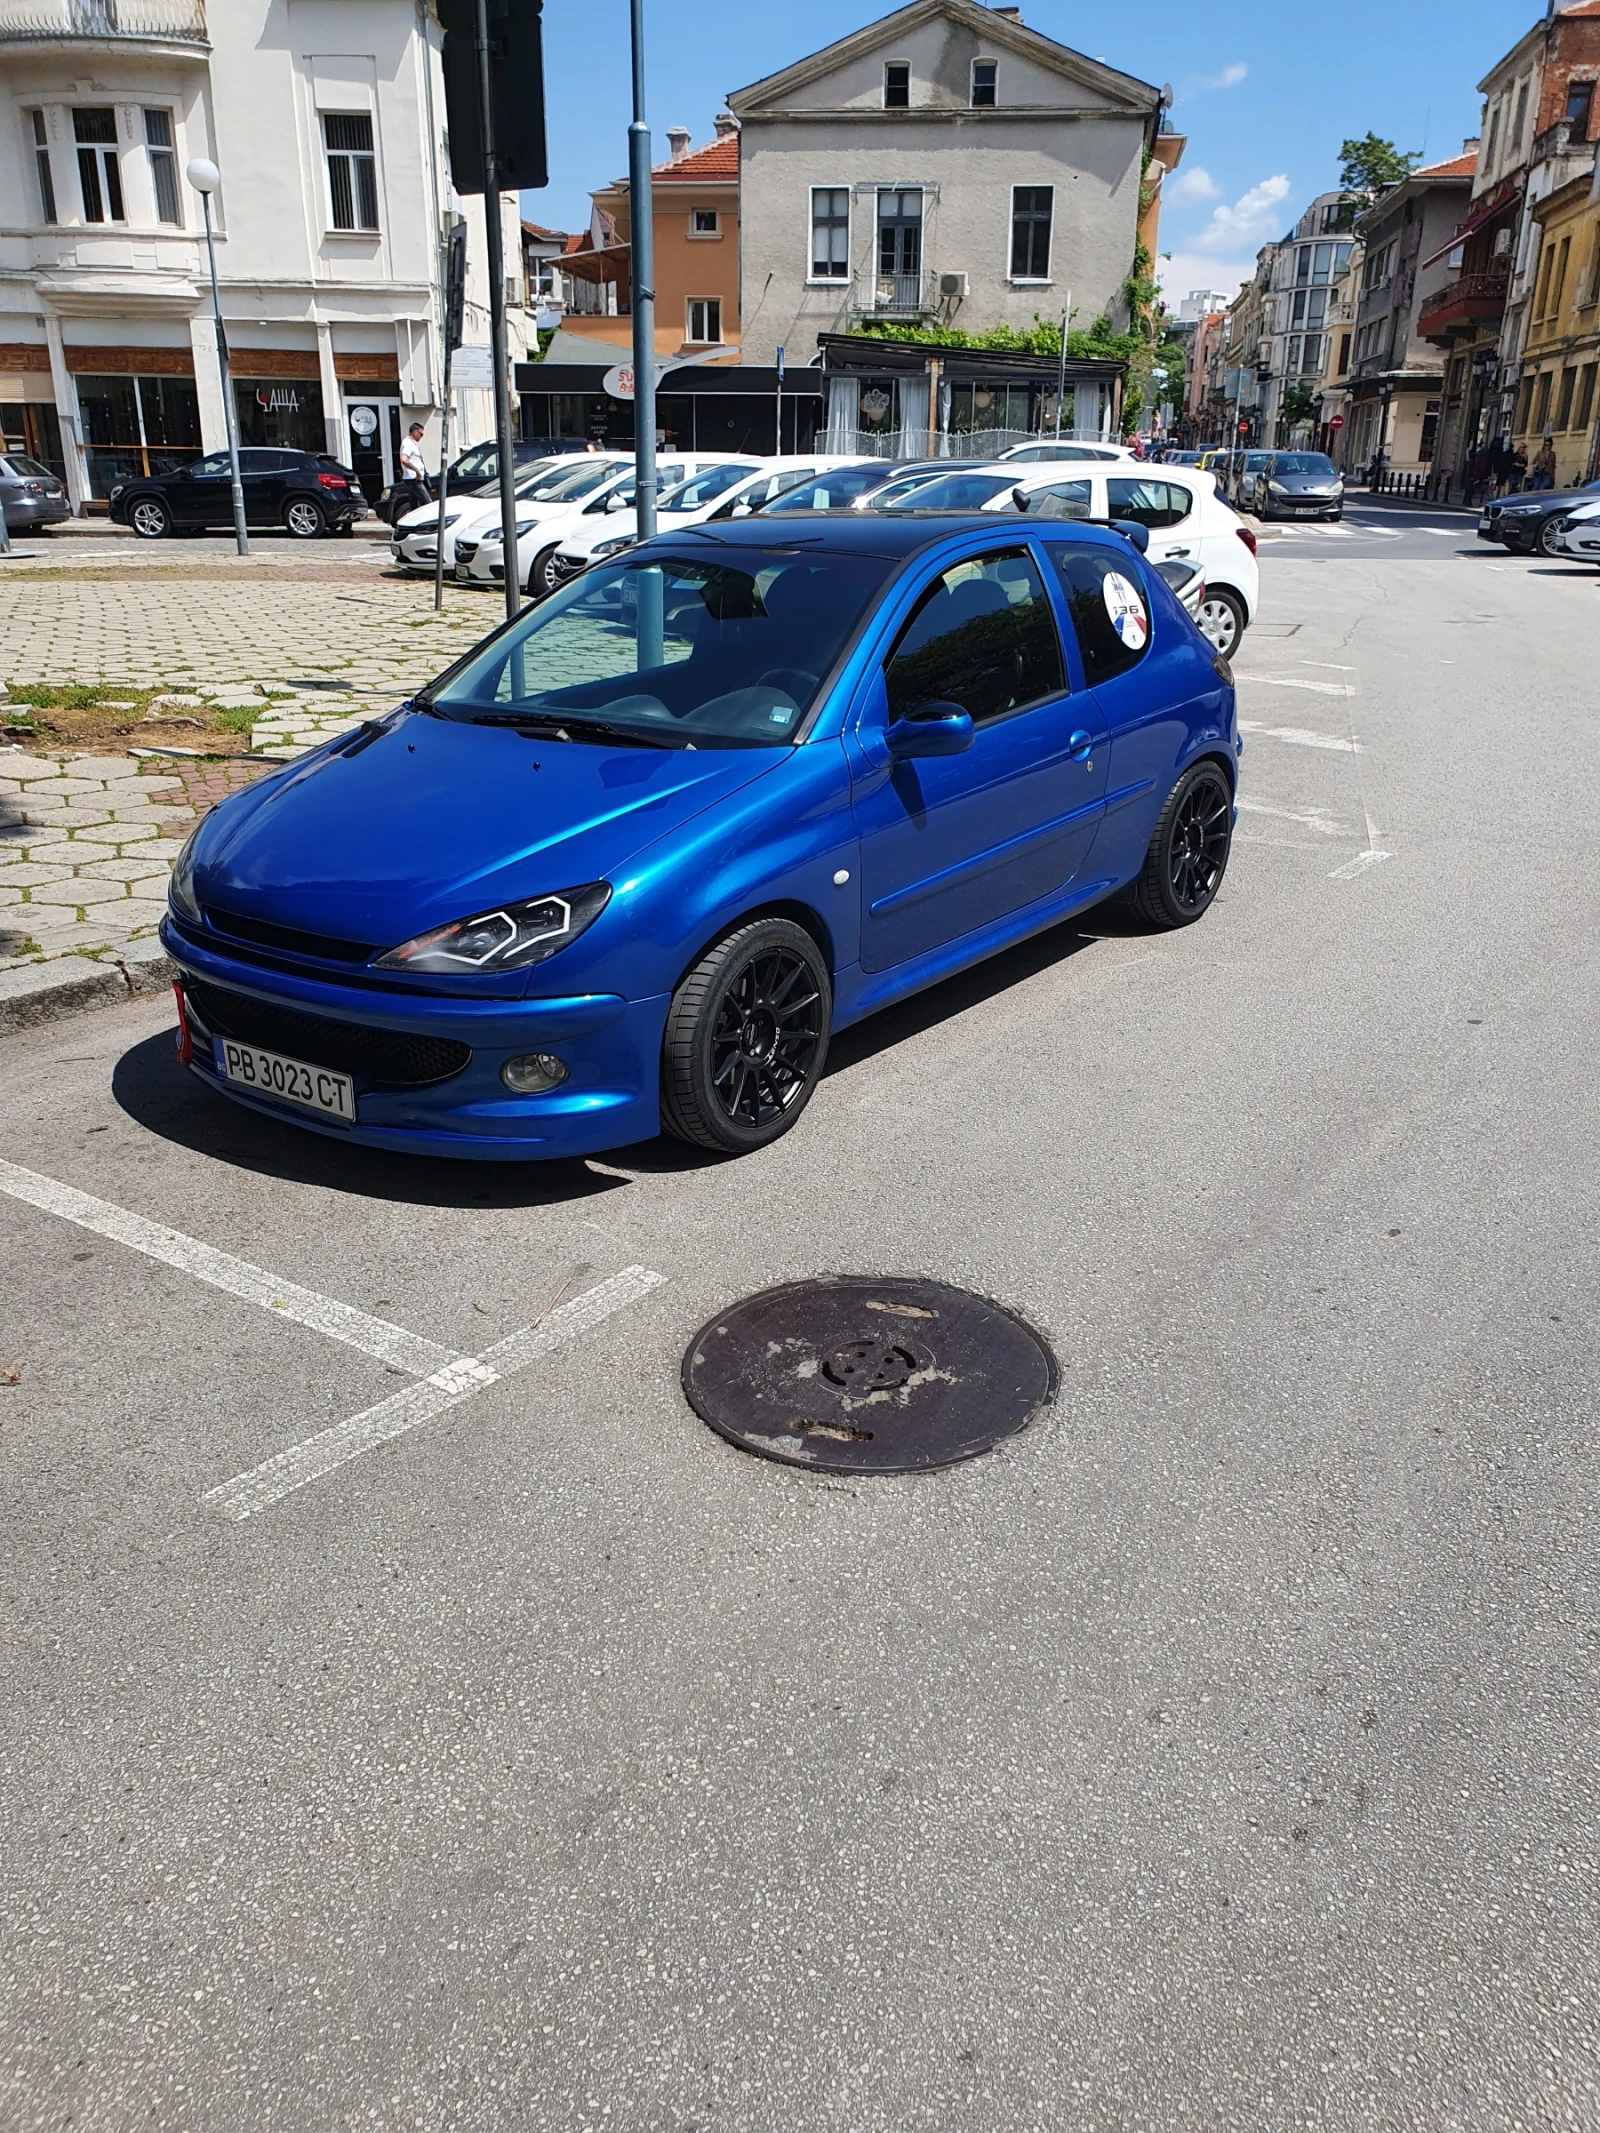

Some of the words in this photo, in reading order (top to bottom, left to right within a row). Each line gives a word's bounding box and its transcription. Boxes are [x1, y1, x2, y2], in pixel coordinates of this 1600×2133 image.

[256, 388, 300, 413] ЧАША
[217, 1061, 227, 1072] BG
[226, 1044, 256, 1082] PB
[259, 1055, 314, 1101] 3023
[317, 1074, 347, 1112] CT
